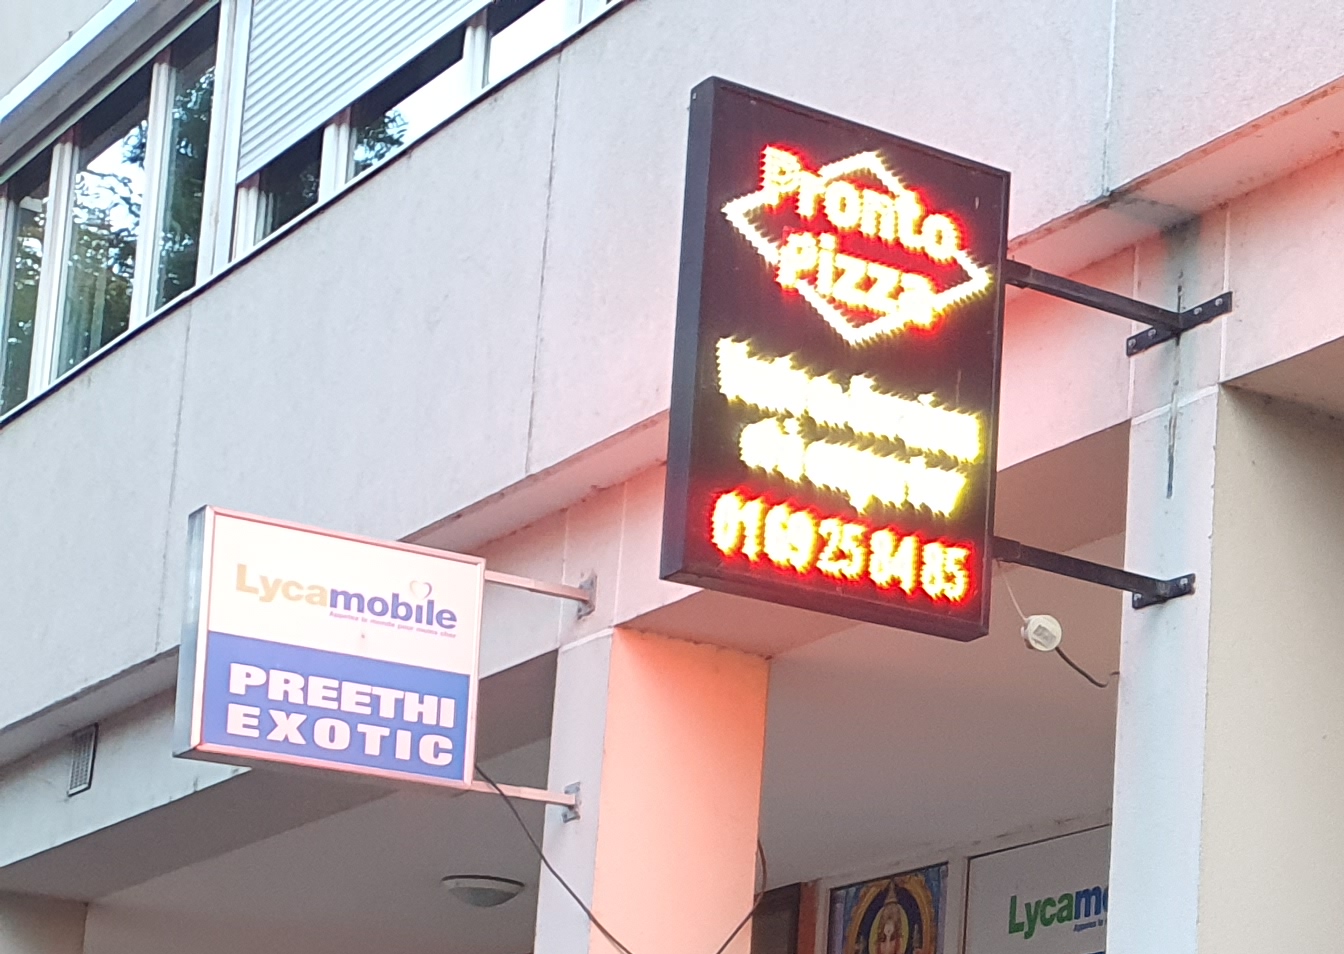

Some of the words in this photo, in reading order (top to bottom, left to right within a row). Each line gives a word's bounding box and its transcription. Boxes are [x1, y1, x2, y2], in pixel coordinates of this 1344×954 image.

[761, 143, 962, 262] Pronto
[776, 230, 938, 332] Pizza
[711, 491, 765, 562] 01
[764, 502, 817, 573] 69
[818, 517, 867, 581] 25
[869, 529, 920, 597] 84
[921, 540, 974, 604] 85
[236, 563, 457, 630] Lycamobile
[226, 703, 453, 766] EXOTIC
[229, 662, 456, 728] PREETHI
